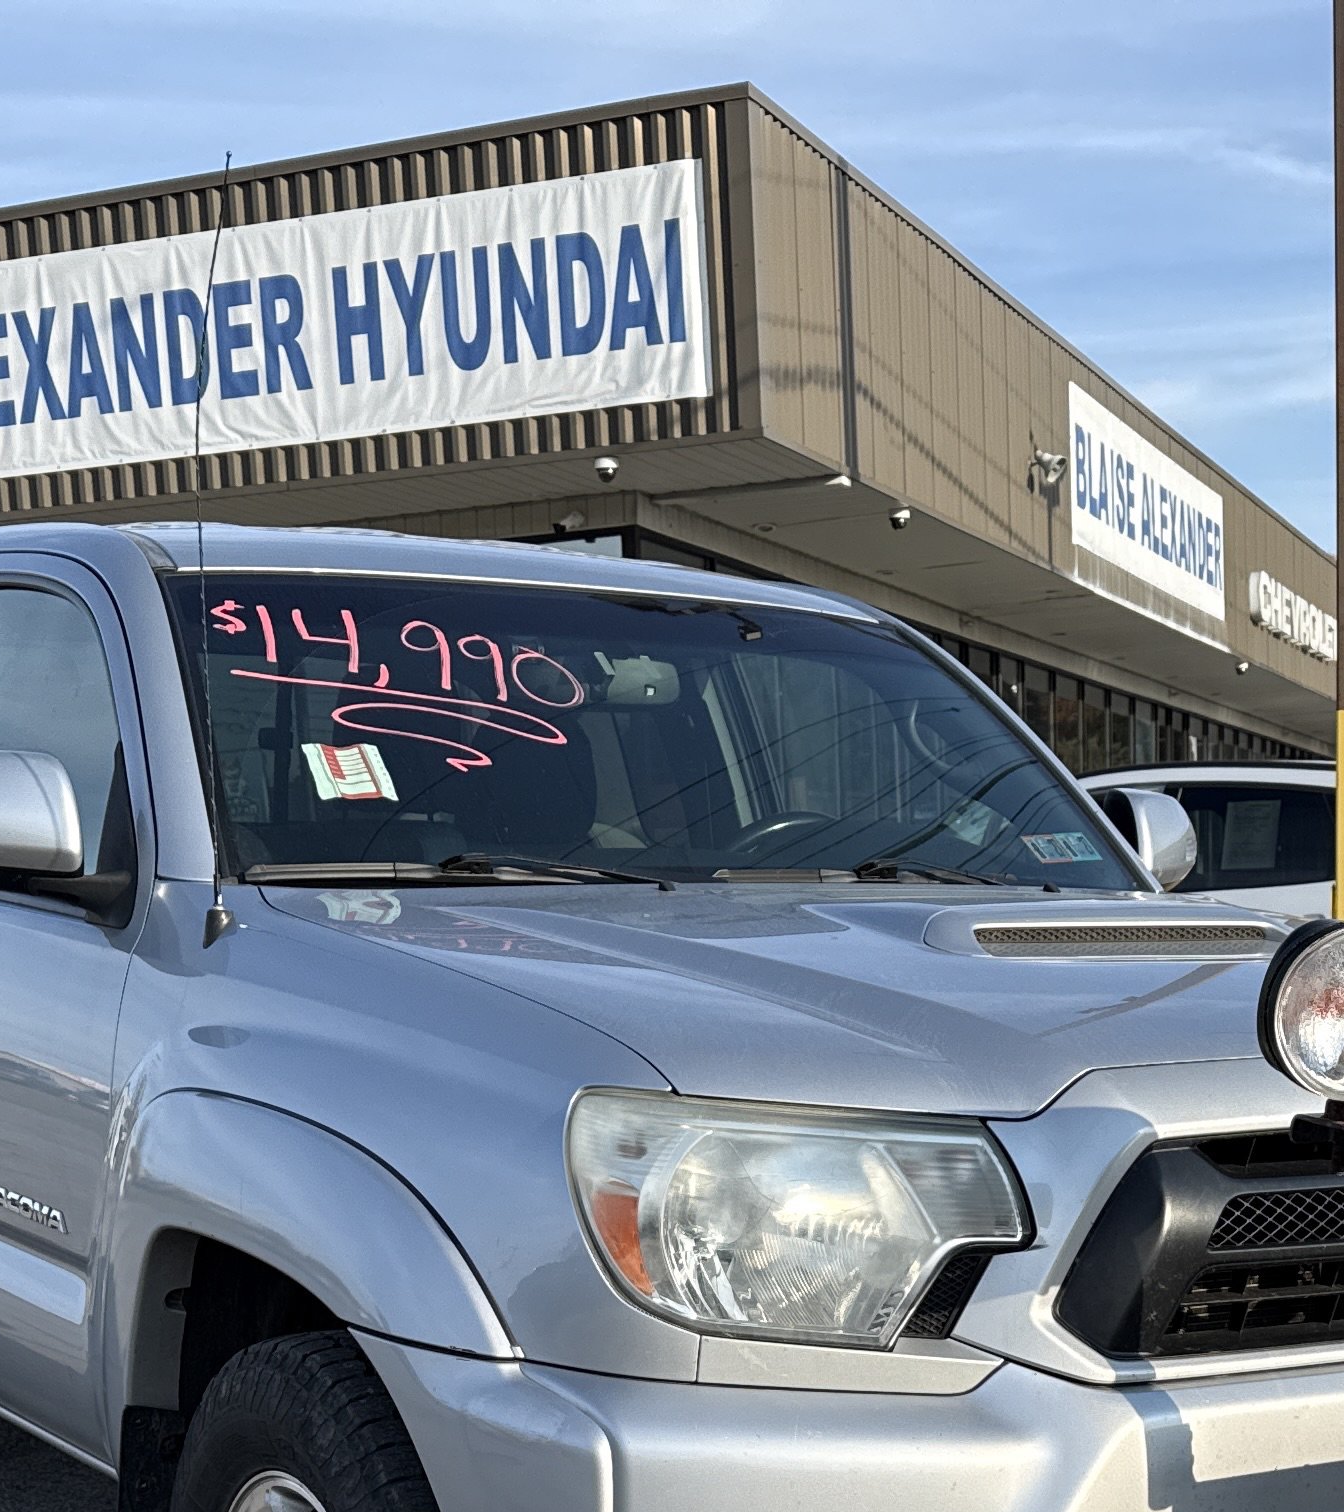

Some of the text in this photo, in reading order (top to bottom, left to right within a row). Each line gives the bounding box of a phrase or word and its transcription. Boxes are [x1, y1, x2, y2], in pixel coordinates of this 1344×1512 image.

[332, 217, 686, 386] HYUNDAI
[1075, 422, 1223, 591] BLAISE ALEXANDER
[210, 600, 585, 708] $14,990
